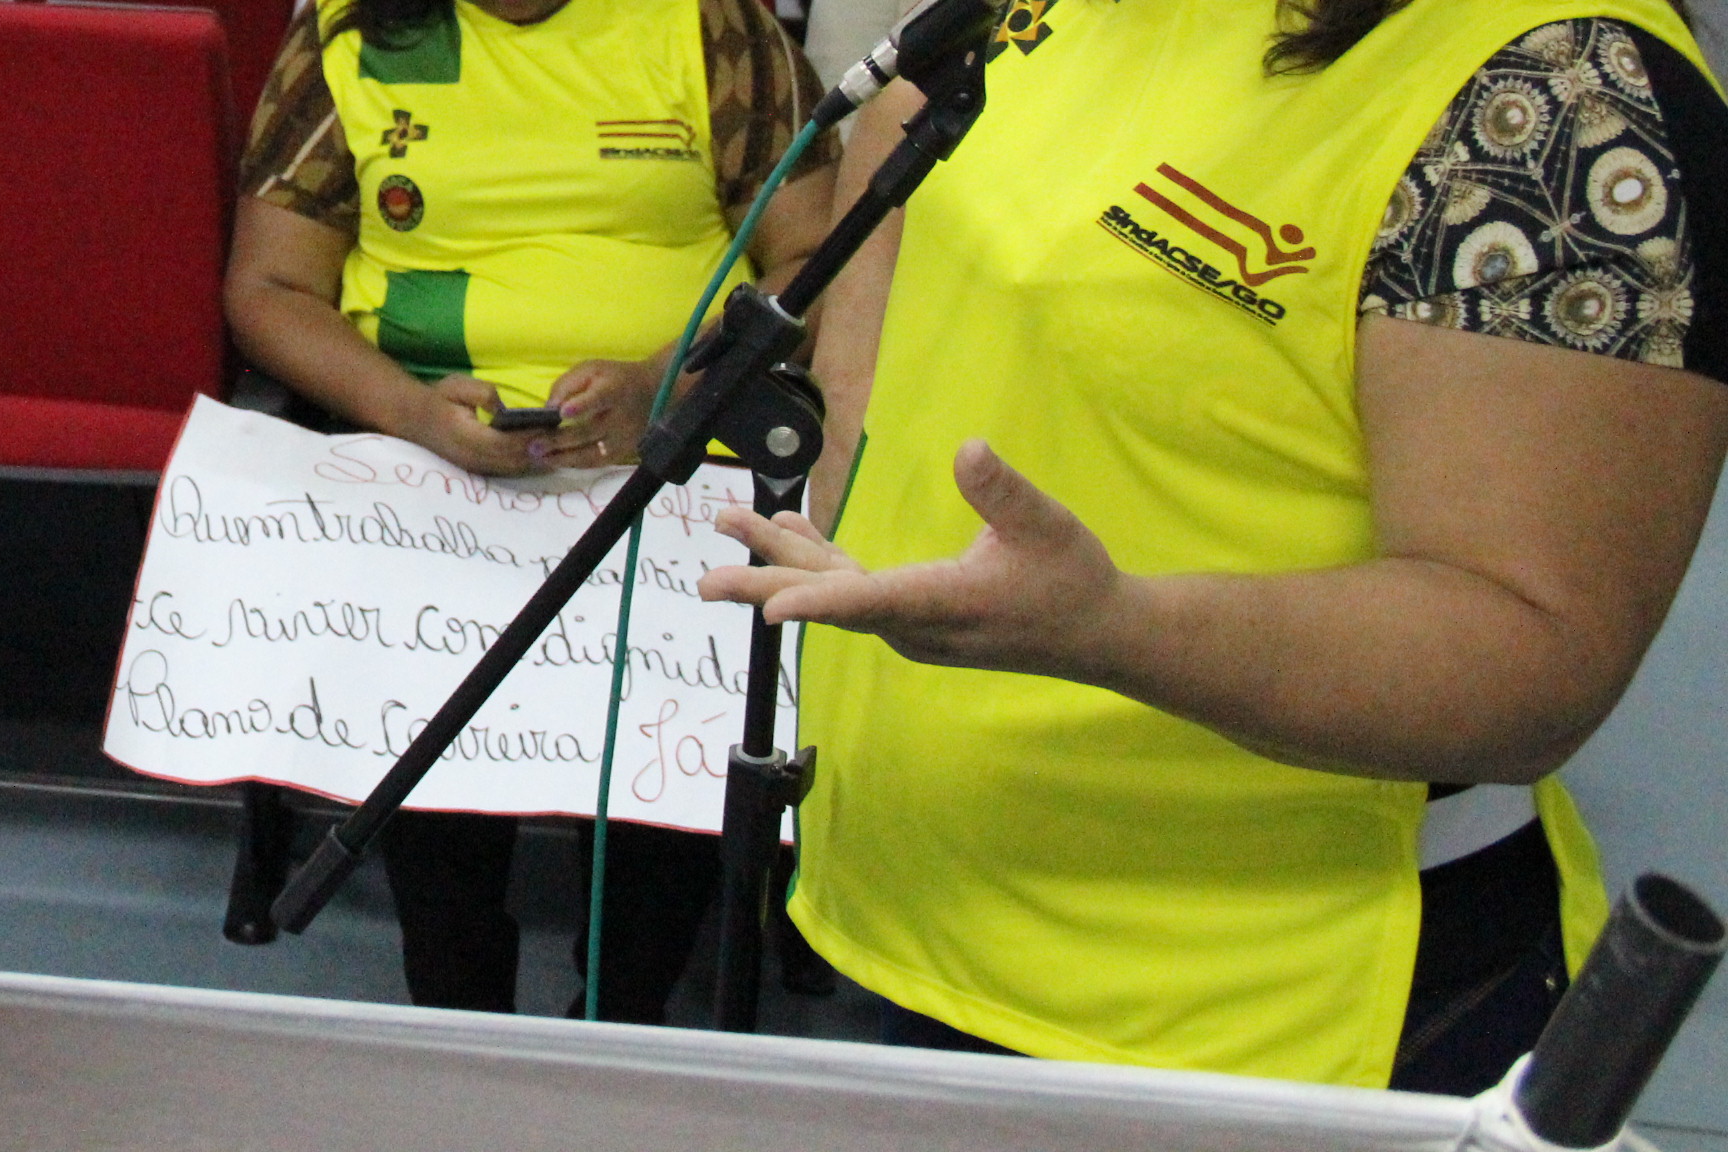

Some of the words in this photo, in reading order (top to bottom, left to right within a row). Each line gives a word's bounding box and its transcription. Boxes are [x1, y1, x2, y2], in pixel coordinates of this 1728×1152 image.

[1102, 205, 1286, 319] SindACSE/GO
[115, 649, 272, 738] Plano
[276, 676, 368, 748] de
[632, 698, 729, 802] Já
